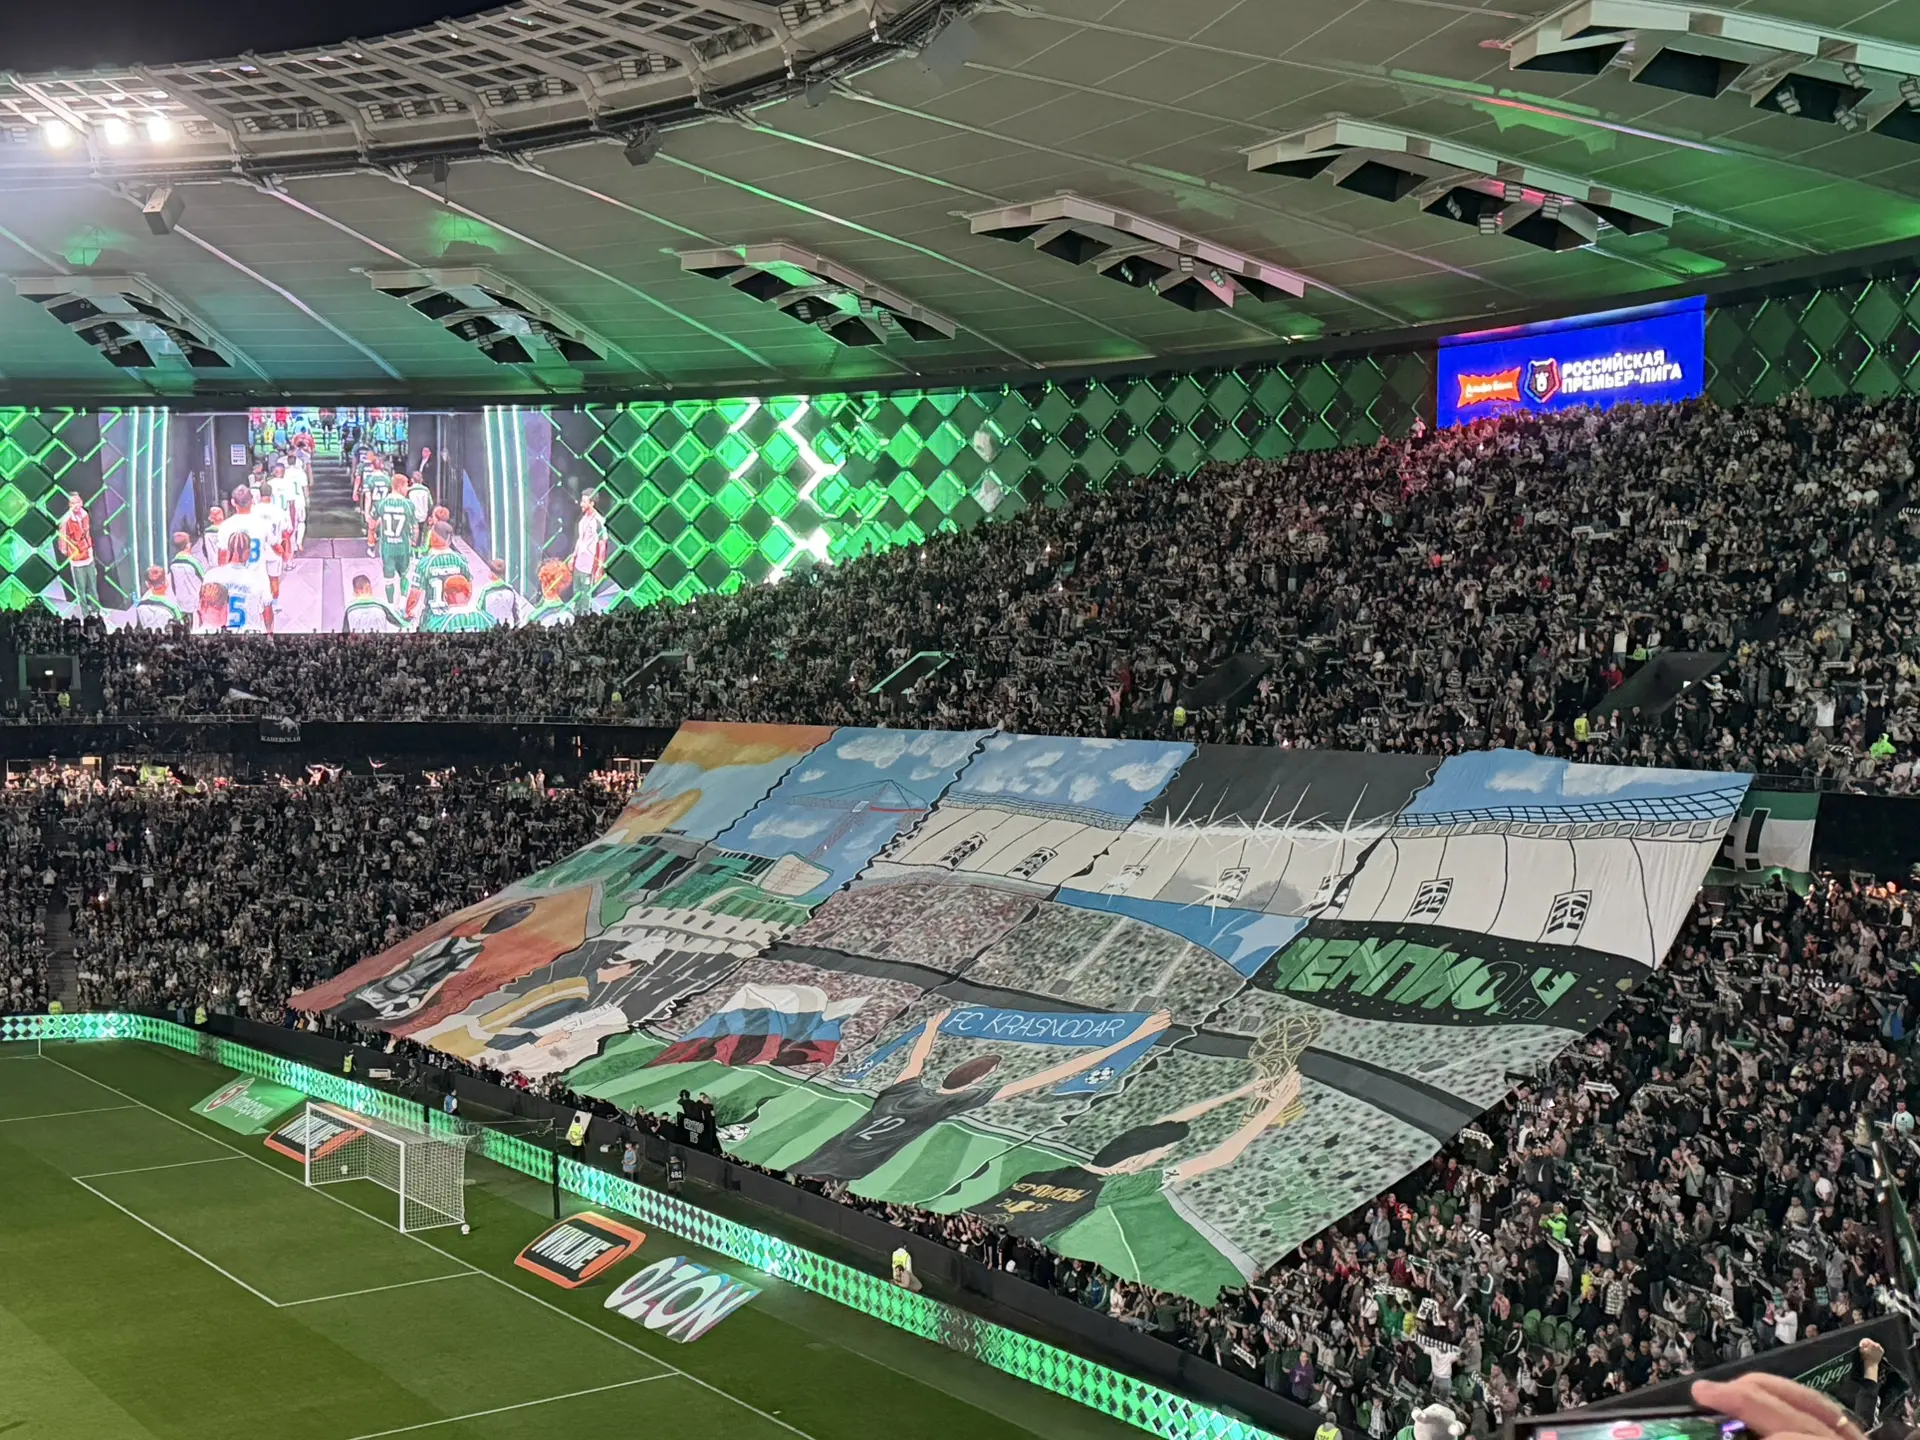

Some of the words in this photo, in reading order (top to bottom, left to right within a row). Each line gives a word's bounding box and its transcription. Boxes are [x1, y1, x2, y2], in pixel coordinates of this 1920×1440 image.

[1561, 363, 1683, 393] ПРЕМЬЕР-ЛИГА
[1562, 350, 1665, 379] РОССИЙСКАЯ
[382, 513, 407, 538] 17
[228, 596, 247, 629] 5
[944, 1011, 984, 1031] FC
[983, 1012, 1126, 1039] KRASNODAR
[854, 1115, 906, 1141] 12
[531, 1224, 614, 1271] WINLINE
[603, 1256, 757, 1344] OZON
